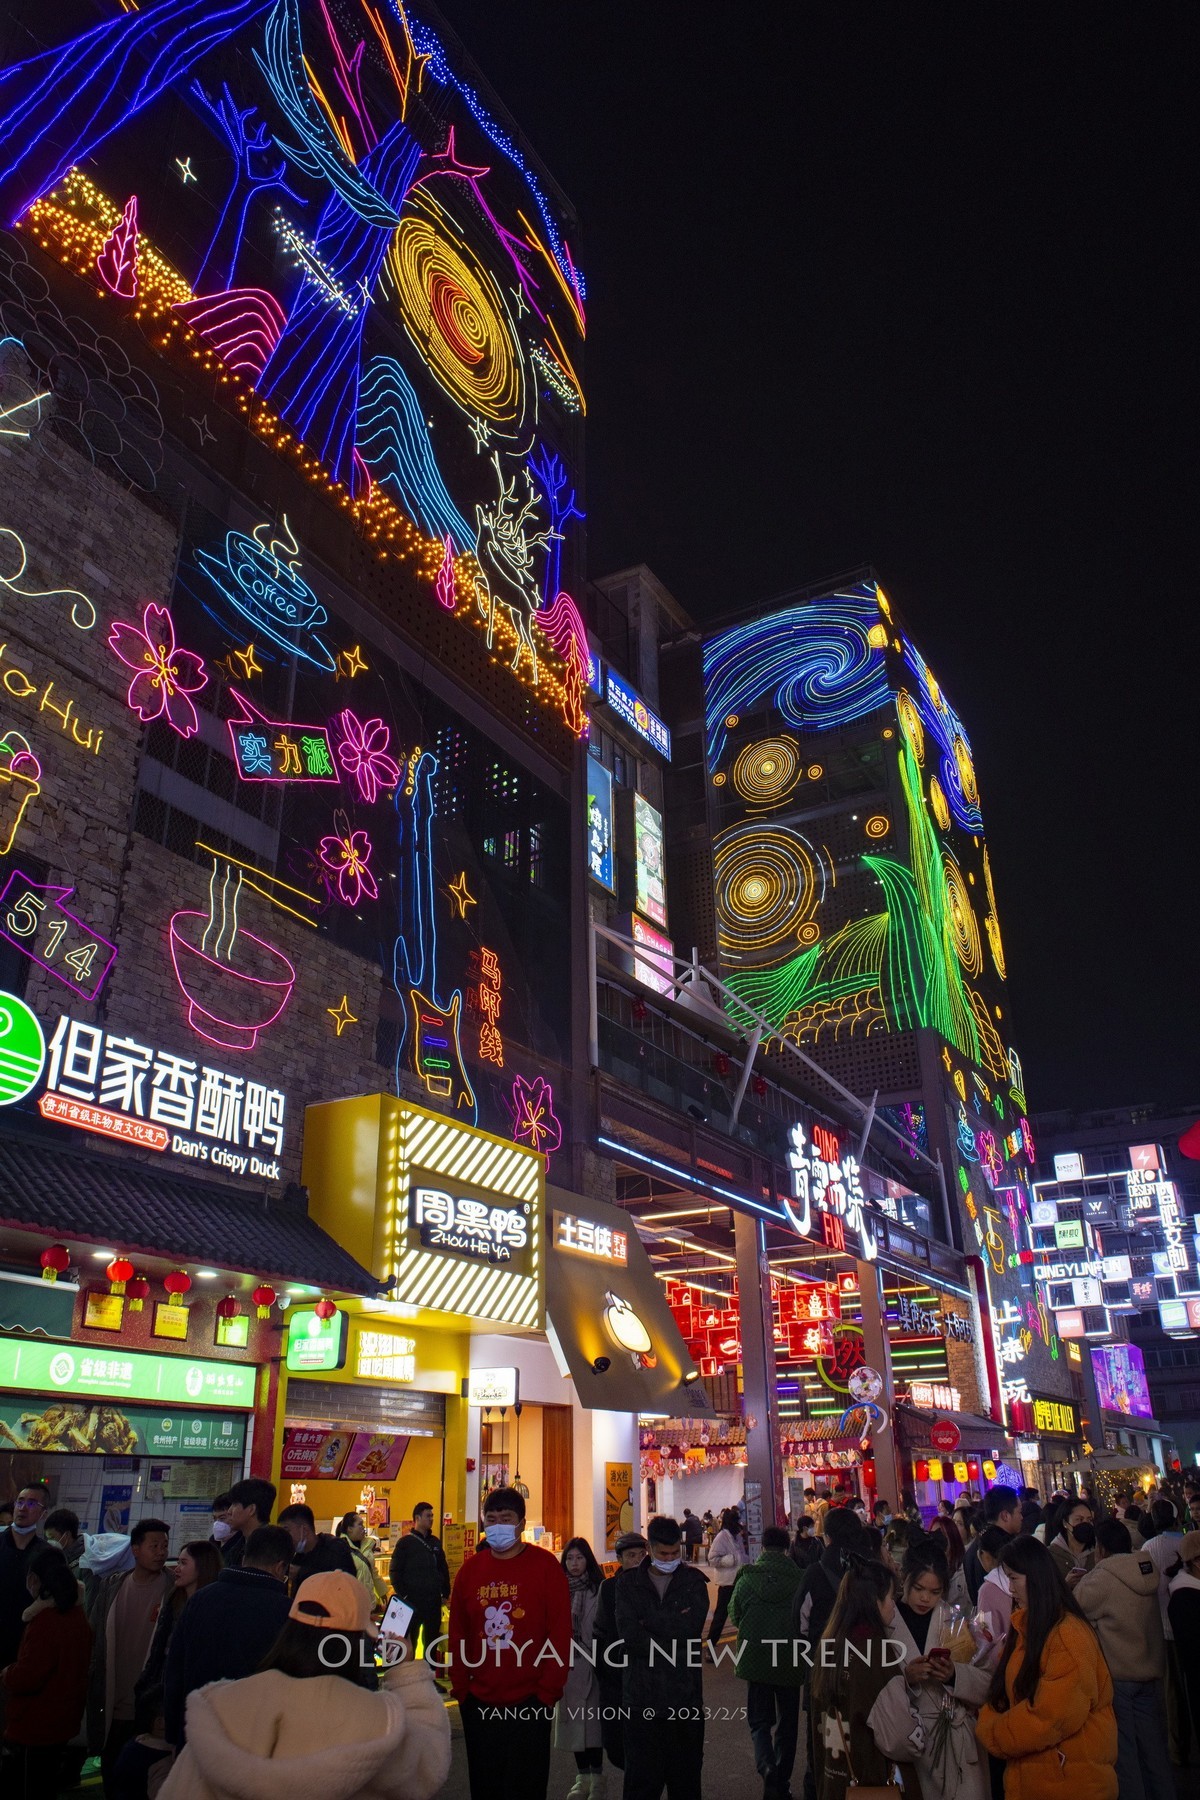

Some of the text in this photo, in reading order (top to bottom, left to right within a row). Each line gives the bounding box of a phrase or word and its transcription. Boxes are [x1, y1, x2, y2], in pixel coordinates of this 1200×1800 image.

[237, 564, 298, 618] Coffee
[238, 732, 334, 776] 实力派
[7, 892, 98, 980] 514
[479, 946, 504, 1067] 马甲线
[46, 1014, 285, 1156] 但家香酥鸭
[44, 1097, 166, 1143] 贵州省级非物质文化遗产
[171, 1135, 281, 1180] Dan's Crispy Duck
[1127, 1169, 1146, 1185] ART
[1128, 1183, 1157, 1197] DESIGN
[1130, 1196, 1152, 1210] LAND
[415, 1188, 527, 1248] 周黑鸭
[559, 1216, 613, 1259] 土豆侠
[824, 1211, 846, 1251] FUN
[430, 1229, 511, 1260] ZHOU HEI YA
[480, 1583, 519, 1599] 财富兔出
